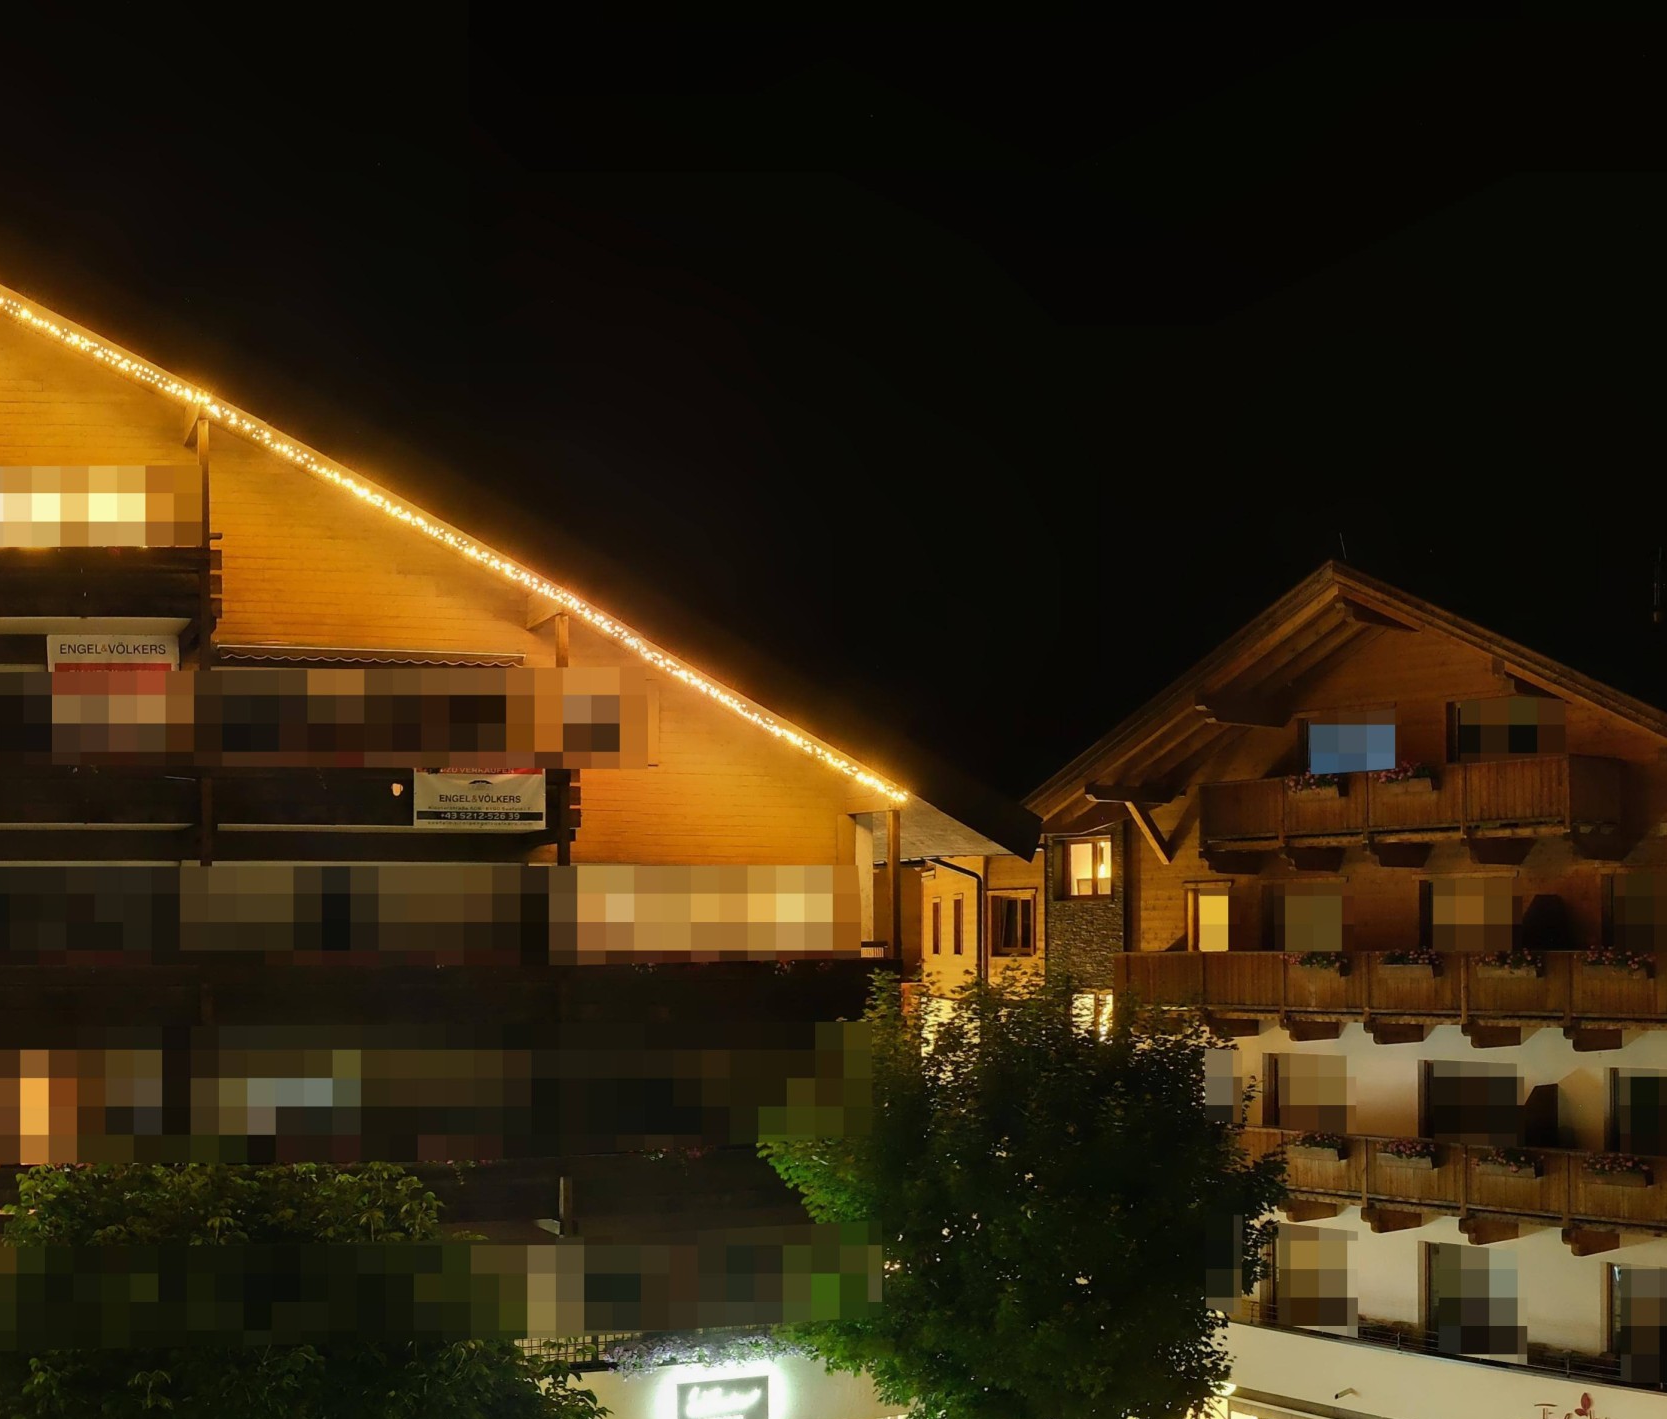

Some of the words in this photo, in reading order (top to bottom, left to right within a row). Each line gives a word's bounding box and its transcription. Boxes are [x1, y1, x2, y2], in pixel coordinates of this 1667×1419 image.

[59, 642, 166, 655] ENGEL&VÖLKERS
[460, 812, 506, 820] 5212-526
[508, 812, 521, 820] 39
